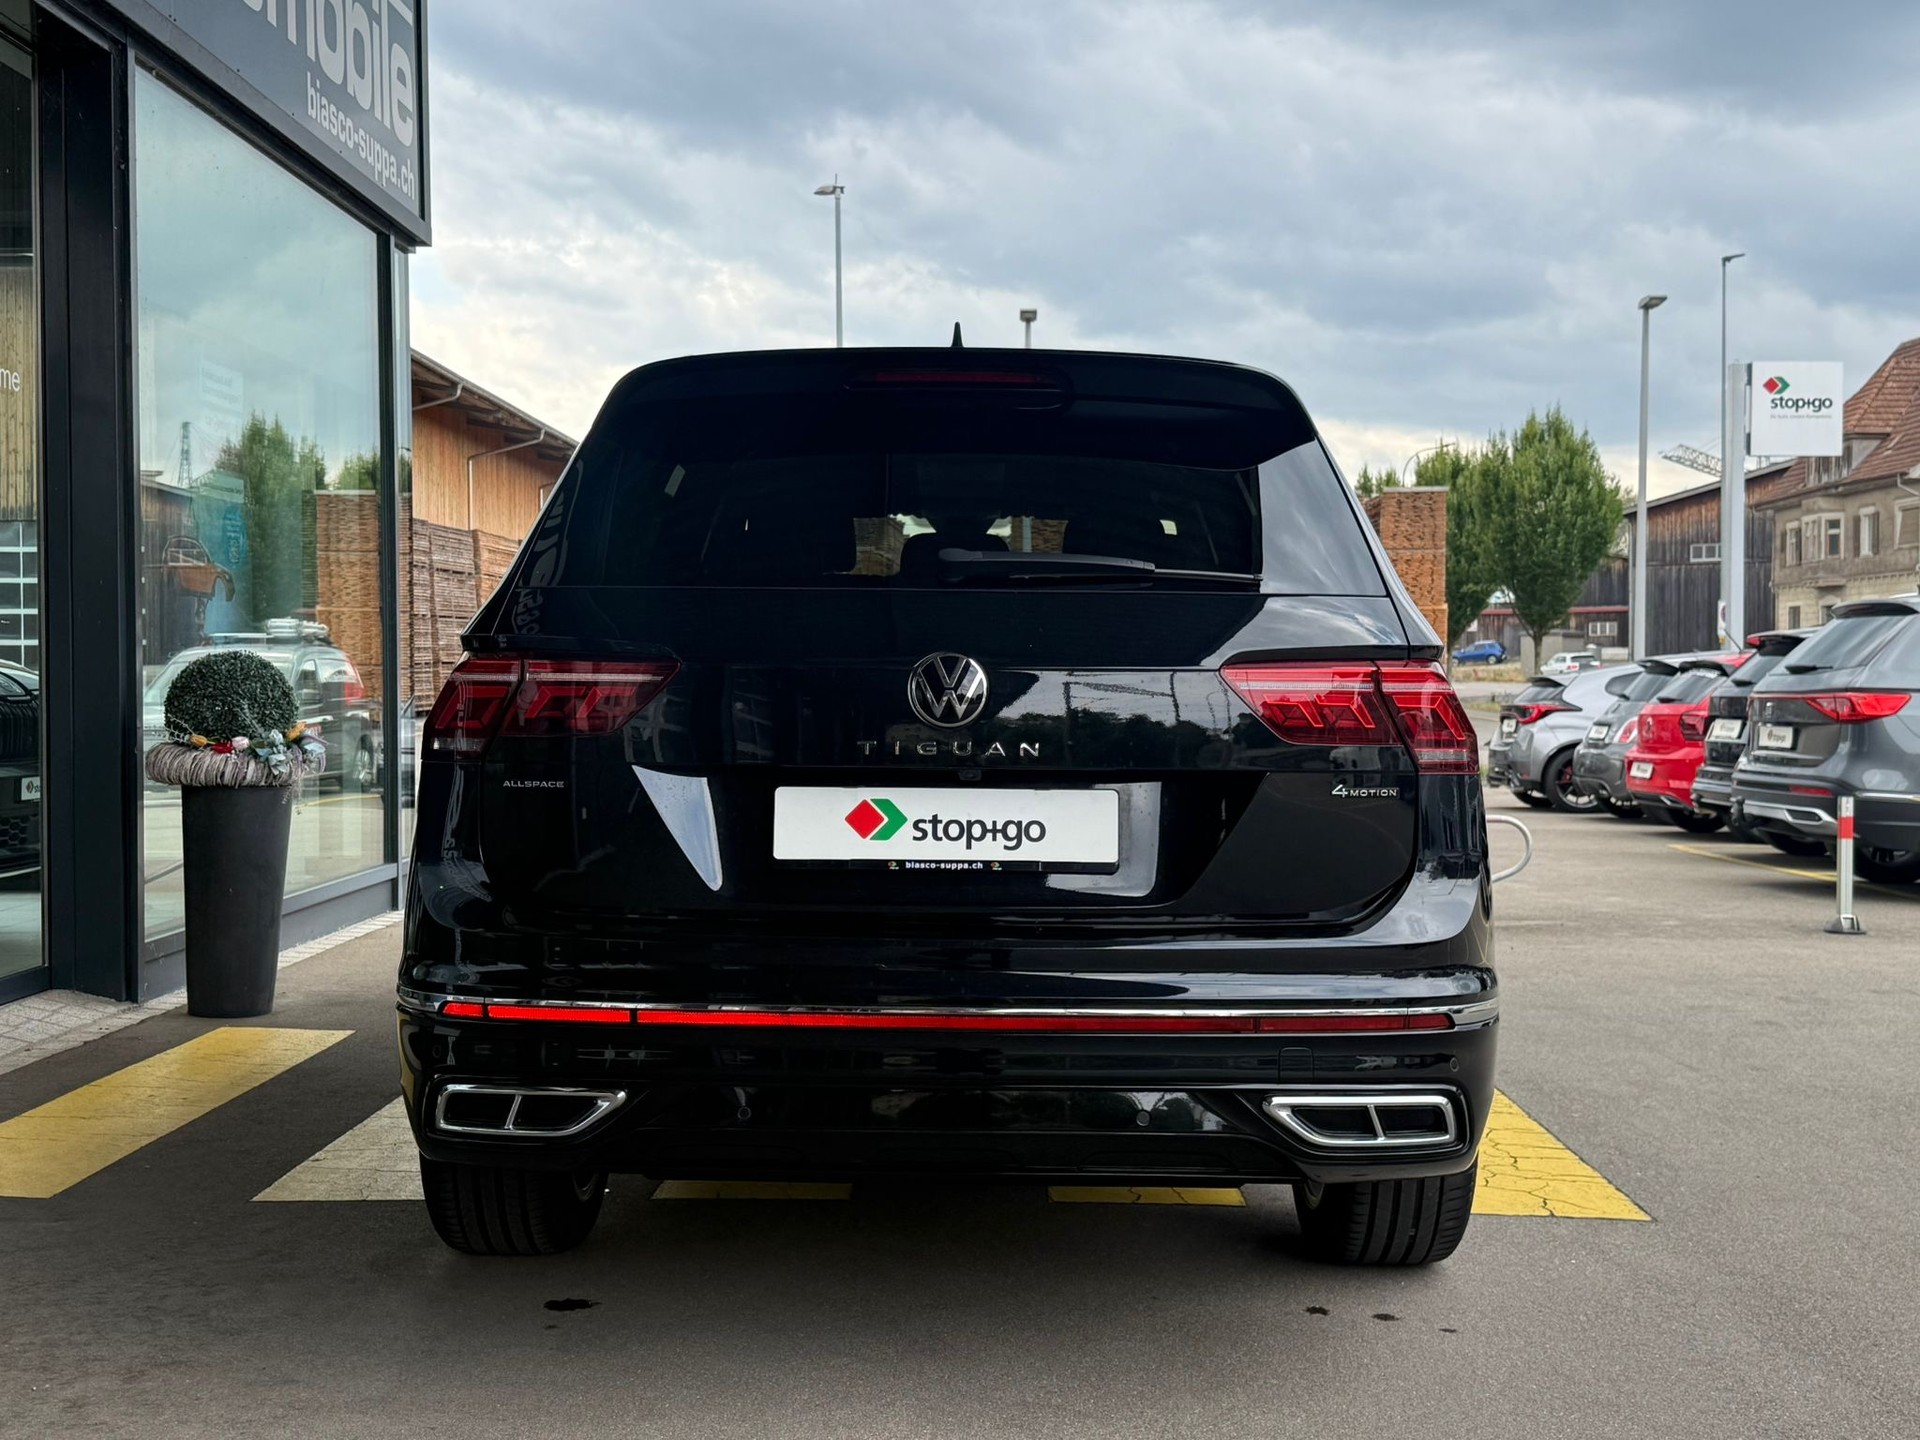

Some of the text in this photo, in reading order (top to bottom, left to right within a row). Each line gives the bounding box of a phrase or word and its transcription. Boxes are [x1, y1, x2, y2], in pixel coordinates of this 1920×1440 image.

[240, 0, 414, 147] obile
[306, 71, 416, 200] biasco-suppa.ch
[1770, 396, 1833, 413] stop+go
[857, 740, 1041, 757] TIGUAN
[503, 780, 565, 788] ALLSPACE
[911, 813, 1047, 850] stop+go
[905, 861, 983, 870] biasco-suppa.ch
